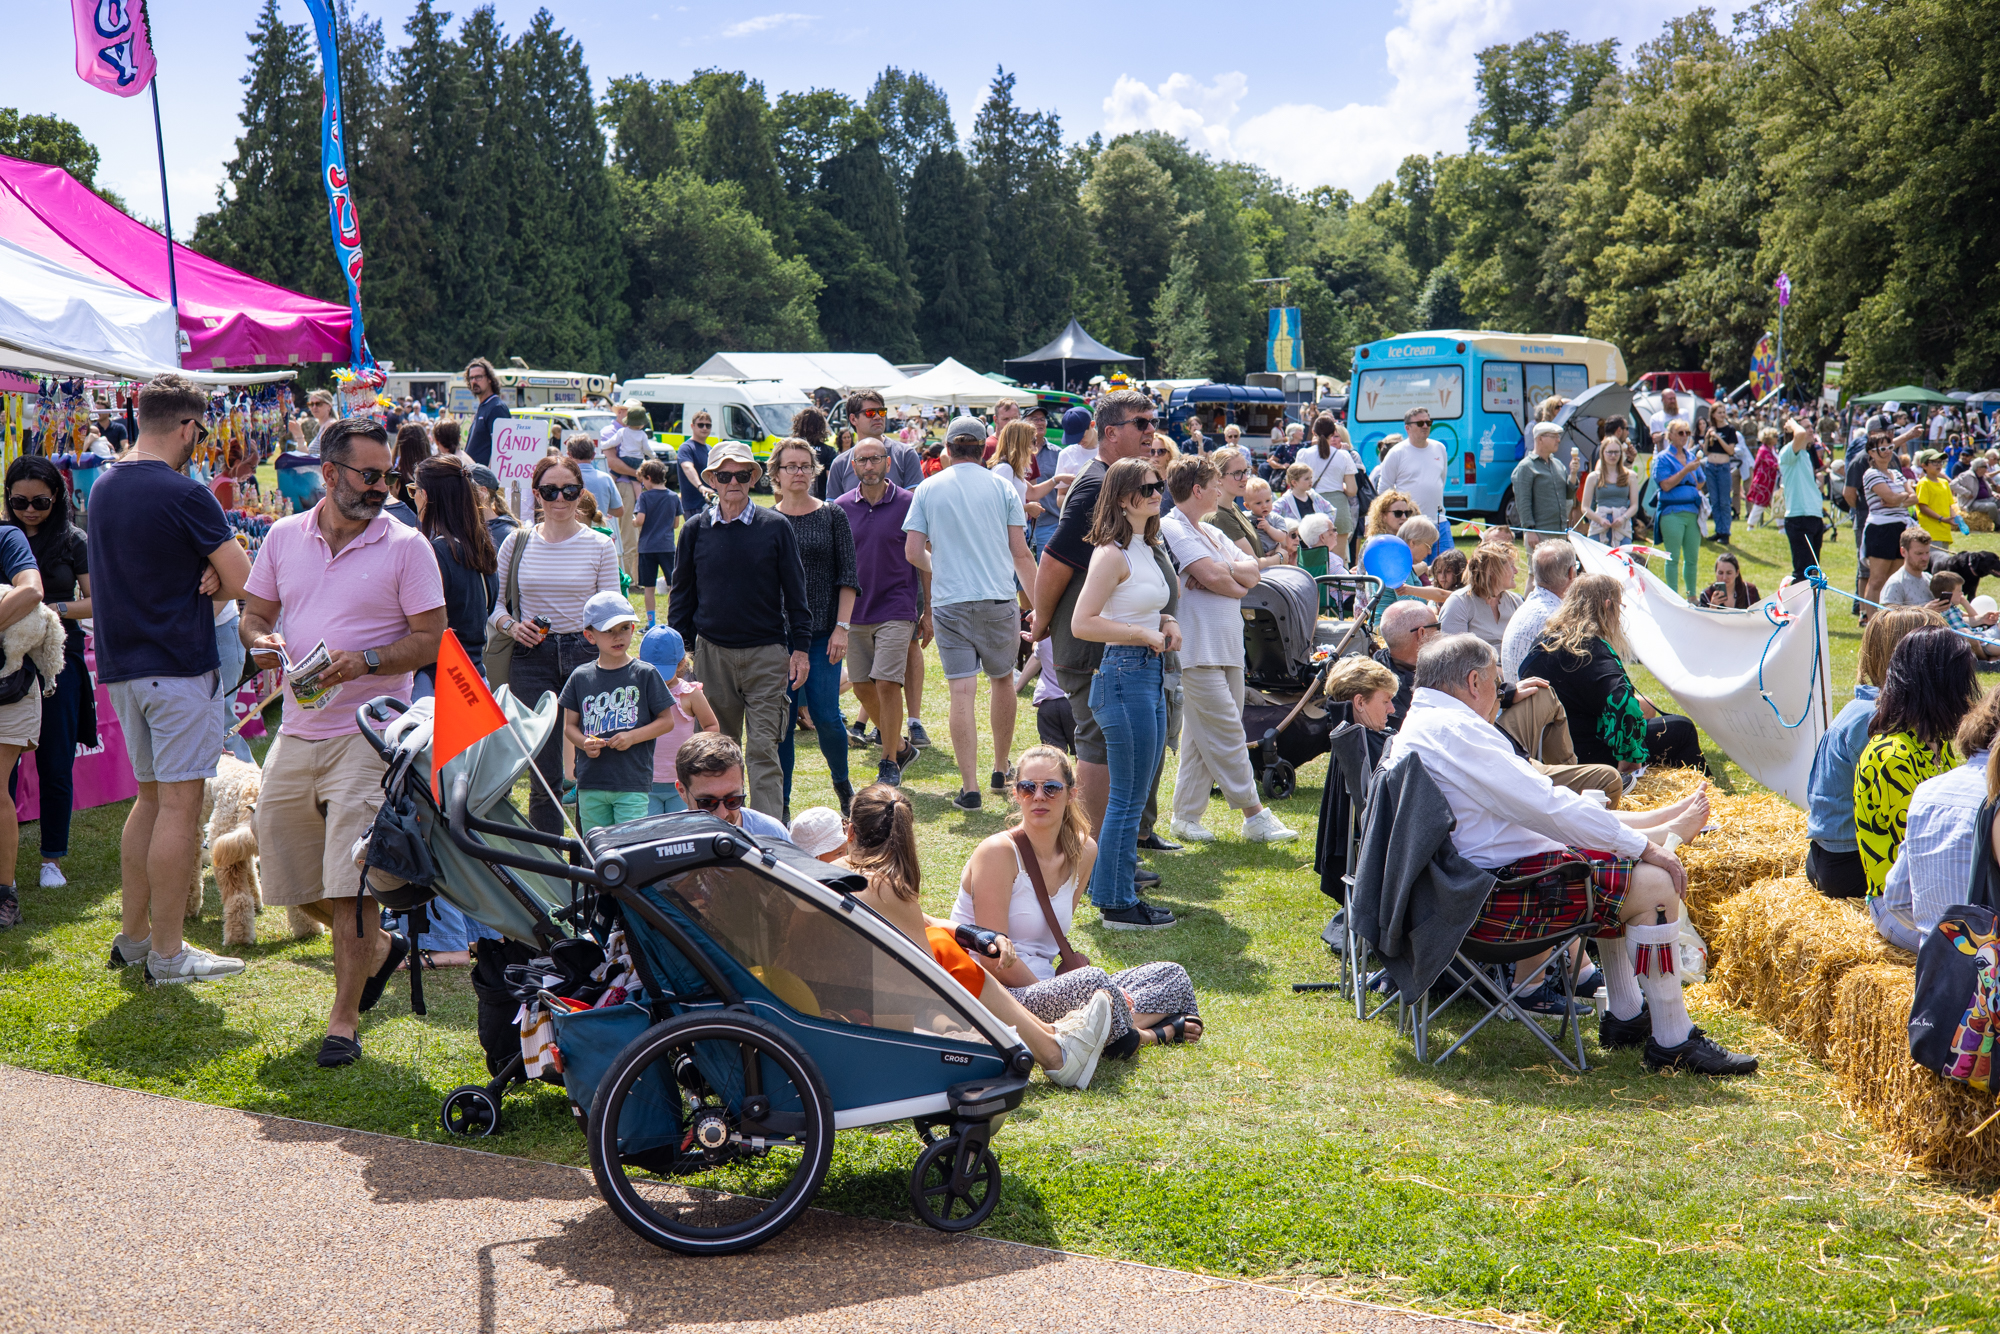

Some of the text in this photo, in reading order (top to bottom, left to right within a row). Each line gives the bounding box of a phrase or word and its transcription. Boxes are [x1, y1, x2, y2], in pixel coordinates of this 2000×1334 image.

[1388, 344, 1436, 358] Ice Cream
[1520, 345, 1528, 353] Mr
[1534, 346, 1544, 354] Mrs
[1545, 346, 1564, 357] Whippy
[582, 686, 640, 716] GOOD
[583, 706, 638, 736] TIMES
[656, 842, 695, 857] THULE
[490, 864, 511, 885] DESIGN
[515, 889, 540, 916] PING TWO
[944, 1054, 968, 1063] CROSS
